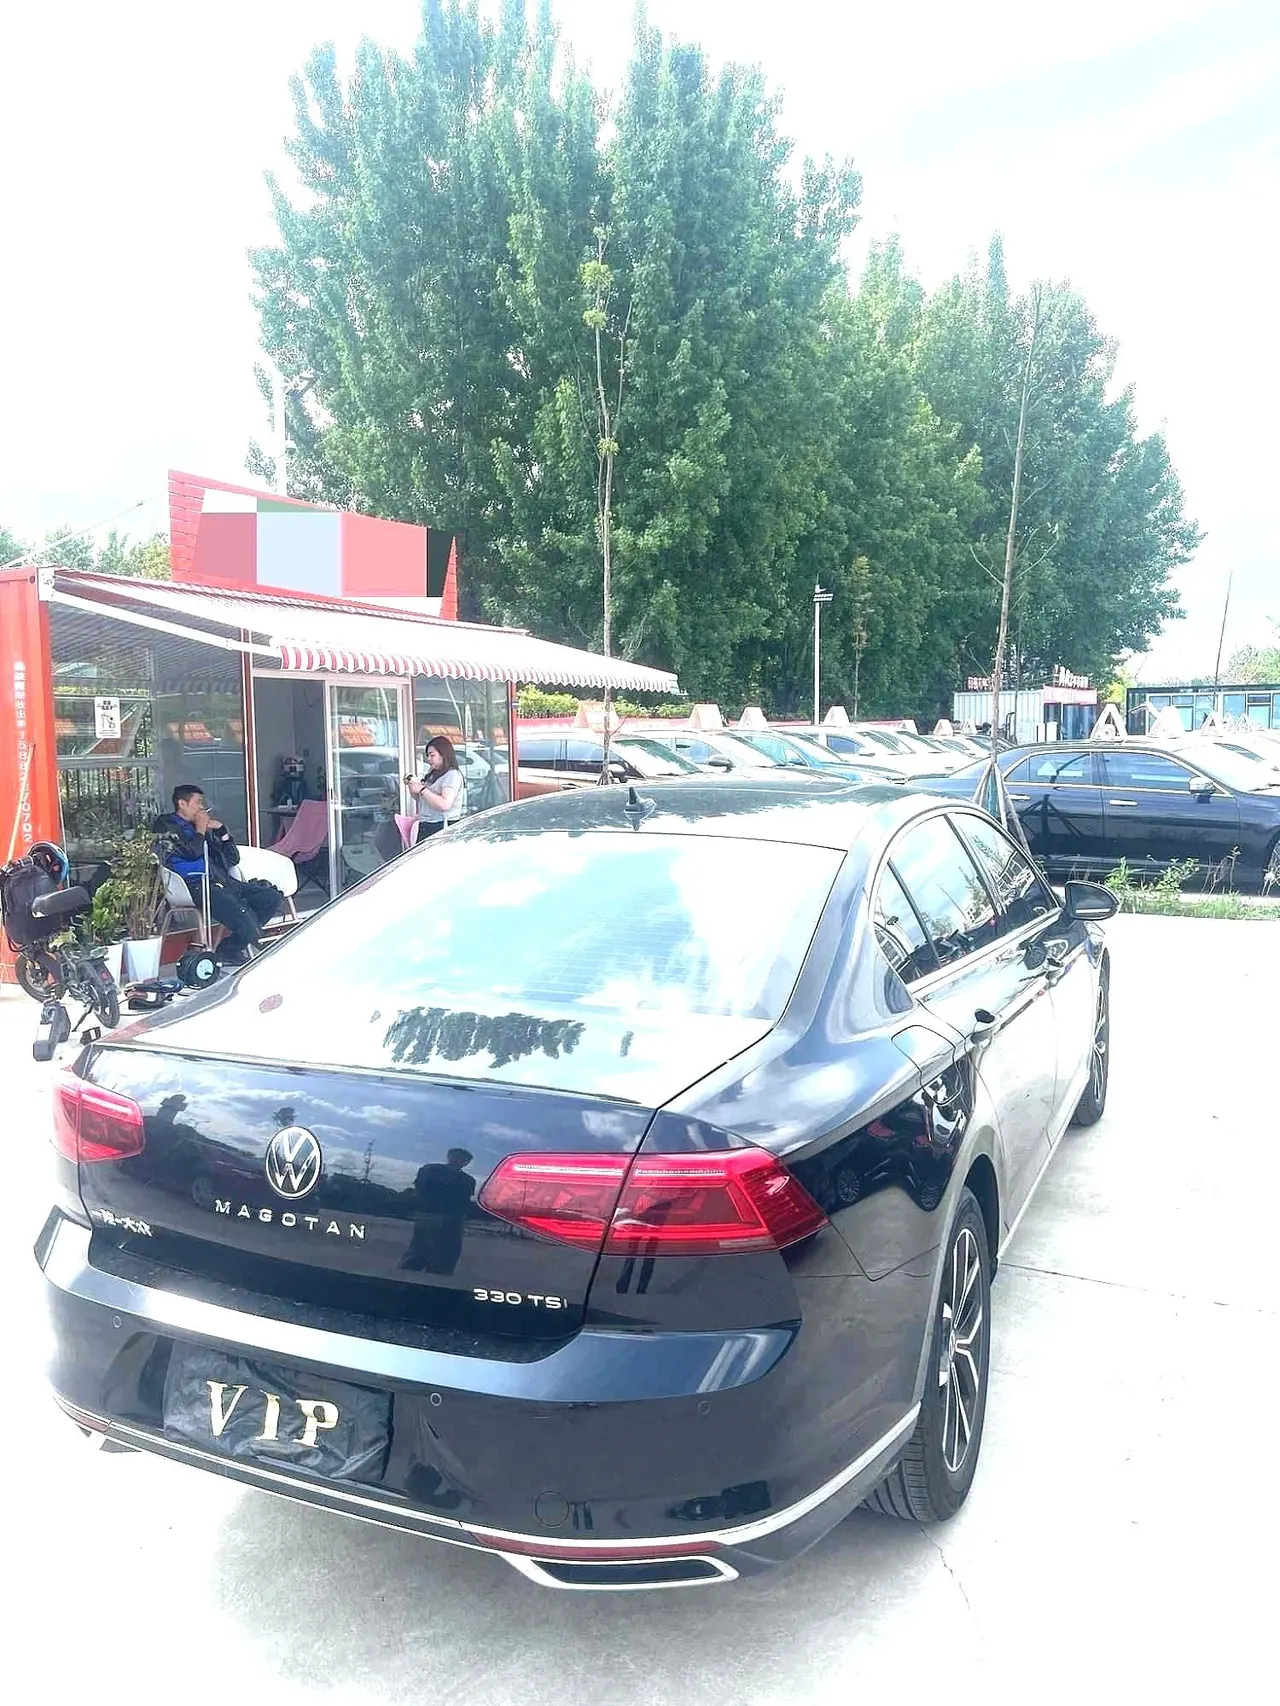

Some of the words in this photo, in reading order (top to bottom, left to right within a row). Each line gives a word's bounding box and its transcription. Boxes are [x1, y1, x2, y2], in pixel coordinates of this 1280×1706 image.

[214, 1199, 365, 1239] MAGOTAN
[473, 1288, 522, 1305] 330
[206, 1379, 340, 1448] VIP
